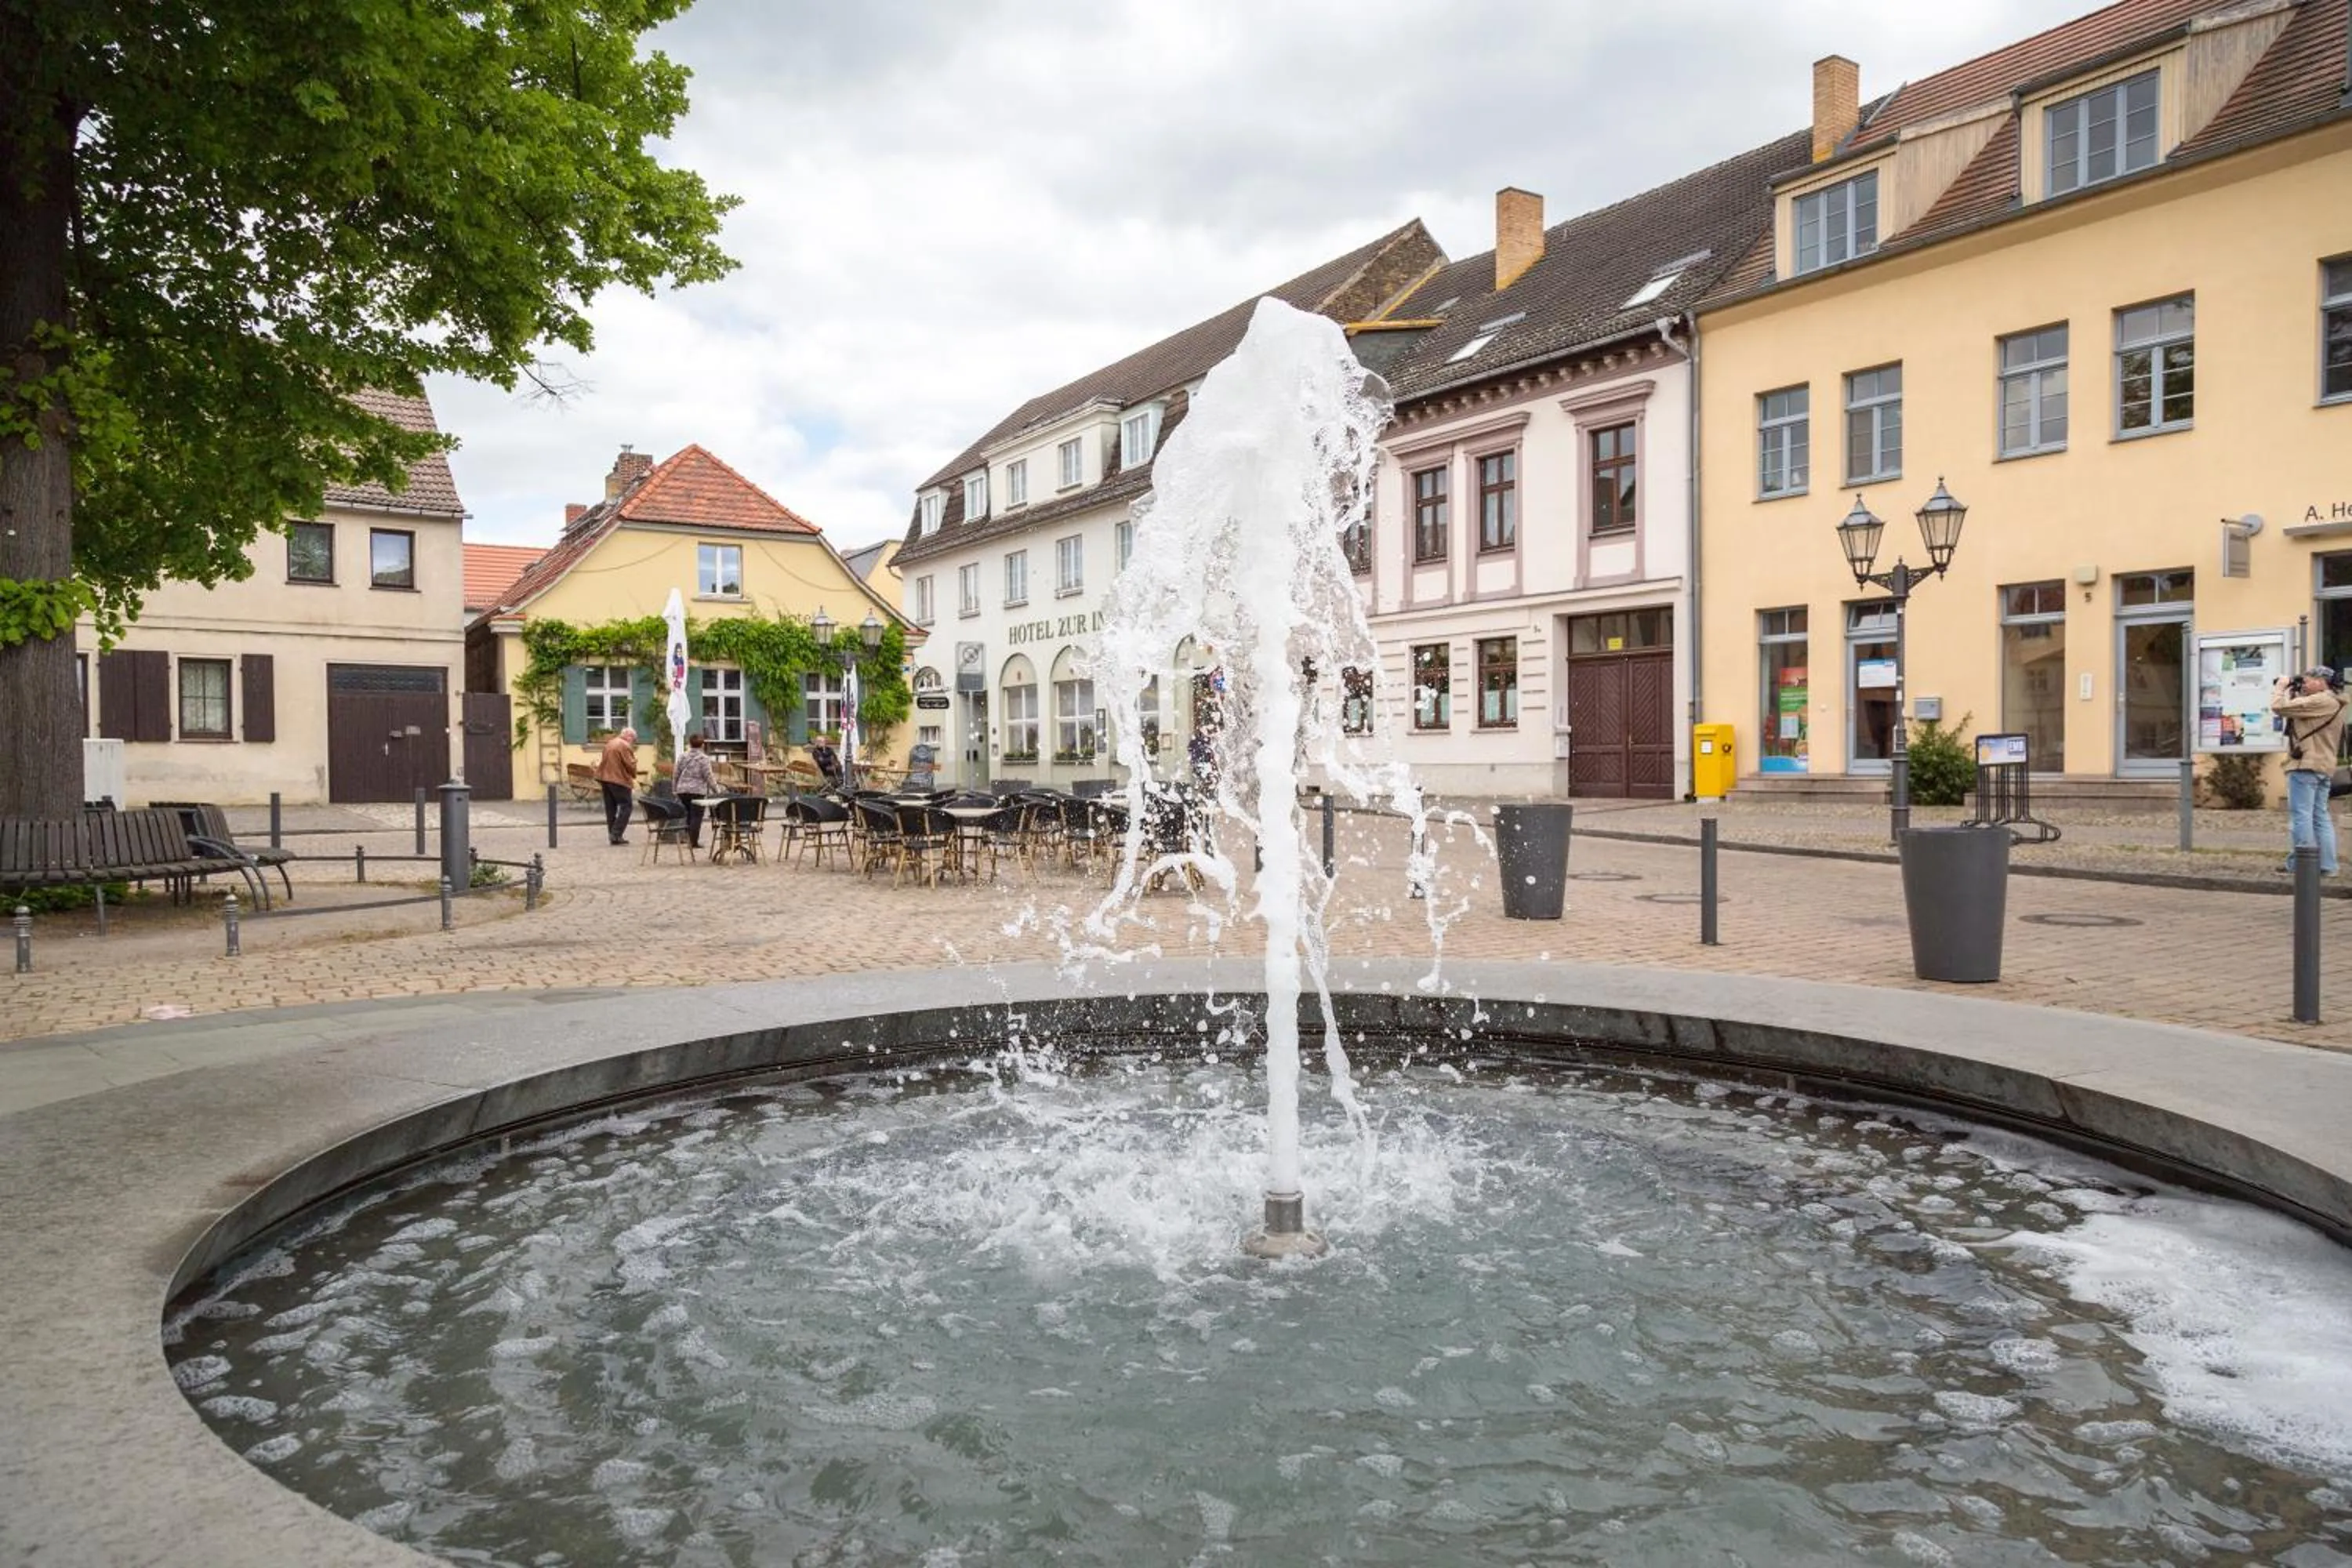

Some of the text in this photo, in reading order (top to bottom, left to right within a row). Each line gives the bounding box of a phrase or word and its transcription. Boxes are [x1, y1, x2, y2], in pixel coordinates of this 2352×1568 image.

[2304, 504, 2324, 522] A.
[1008, 620, 1054, 644] HOTEL
[1058, 614, 1087, 637] ZUR
